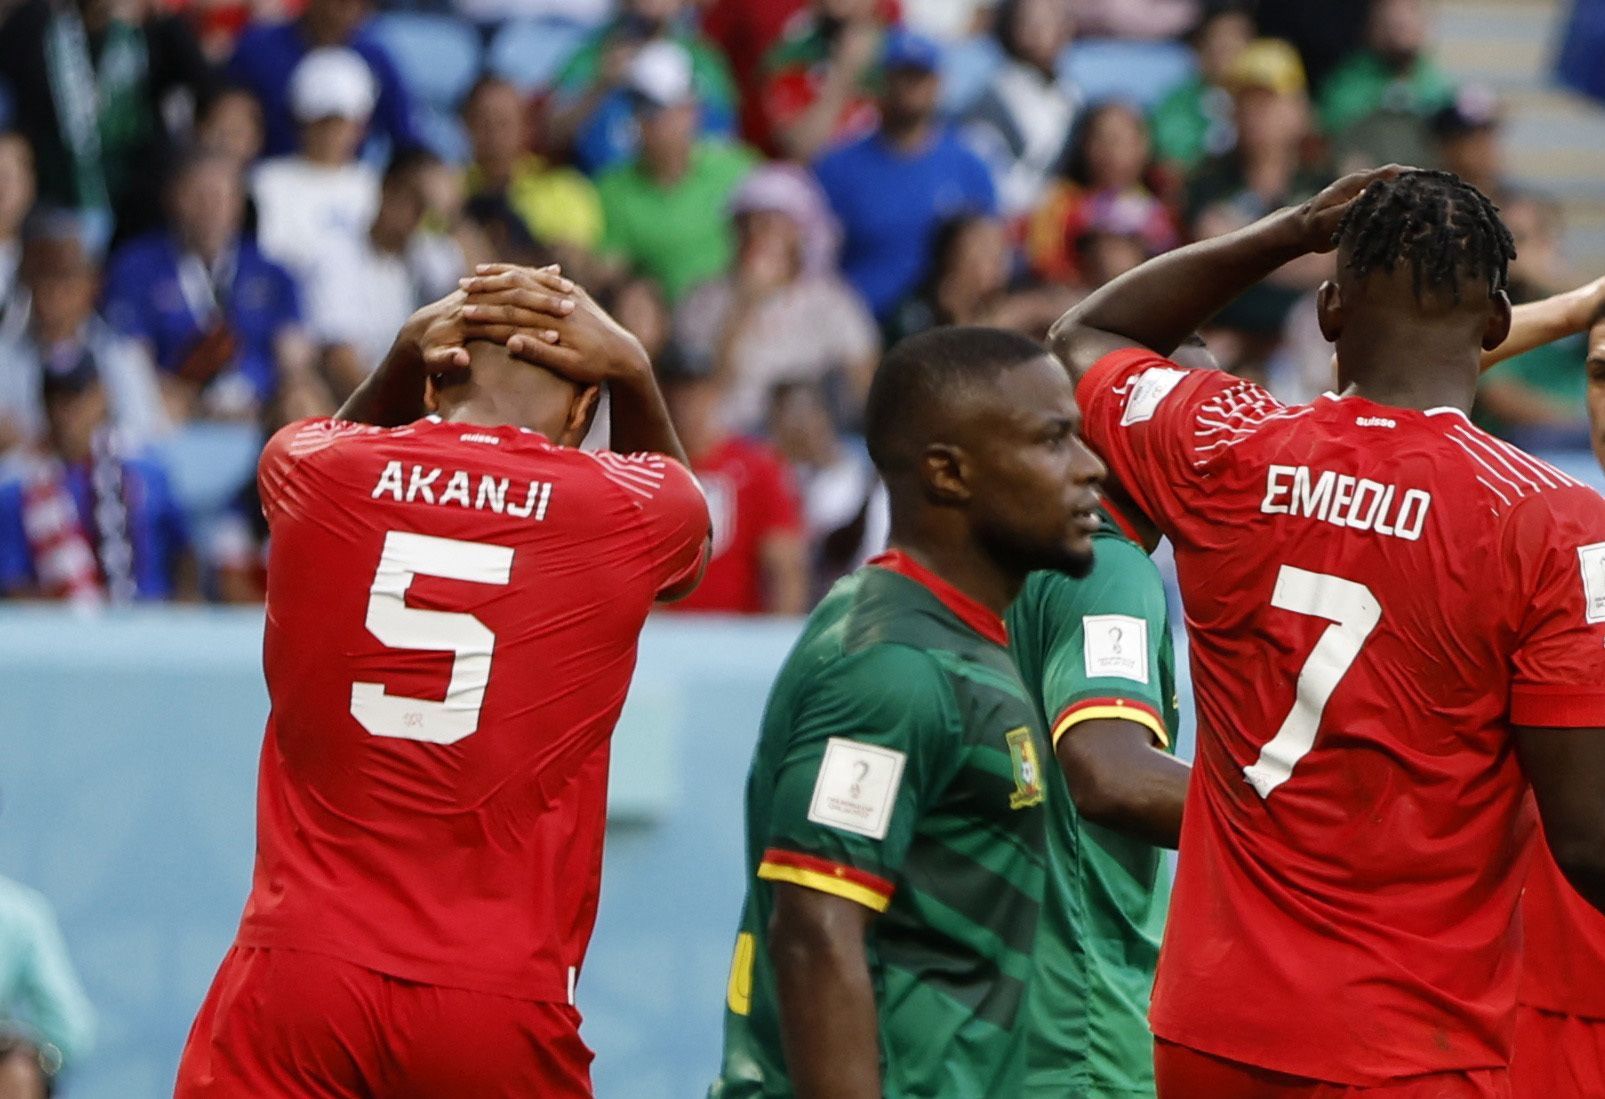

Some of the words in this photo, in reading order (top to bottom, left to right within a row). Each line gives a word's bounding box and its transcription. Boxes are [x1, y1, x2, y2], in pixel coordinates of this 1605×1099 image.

[371, 460, 552, 521] AKANJI
[1356, 416, 1397, 429] suisse
[350, 530, 515, 745] 5
[1243, 564, 1381, 799] 7
